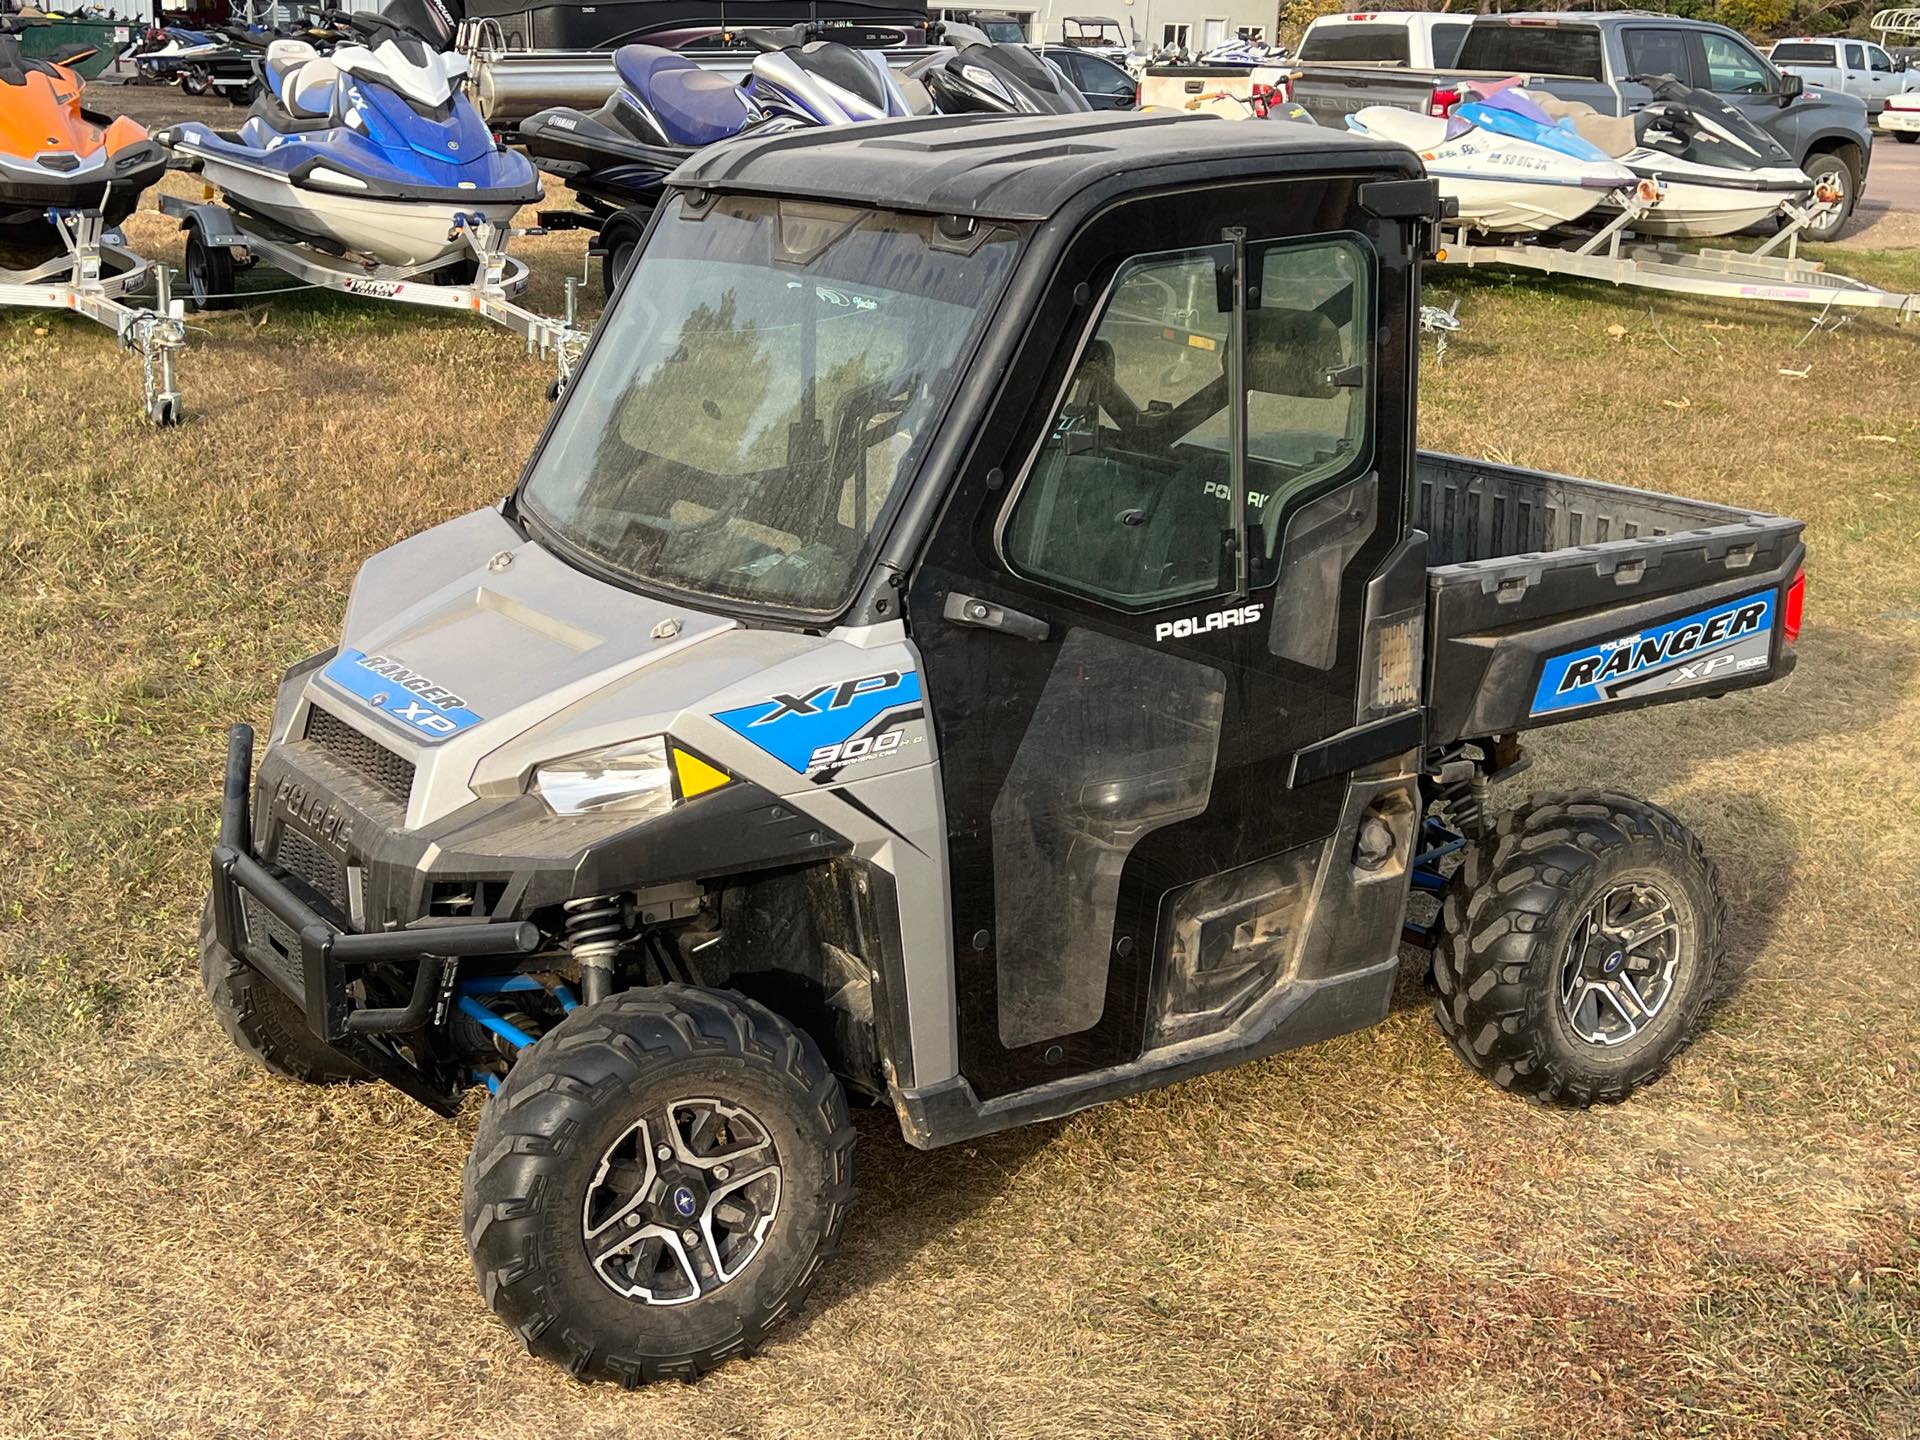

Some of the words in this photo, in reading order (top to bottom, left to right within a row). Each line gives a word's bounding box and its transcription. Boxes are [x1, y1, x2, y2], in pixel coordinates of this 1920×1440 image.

[1295, 95, 1418, 113] CHEVRT
[1203, 481, 1270, 509] PORI
[1156, 604, 1262, 642] POLARIS
[1556, 601, 1768, 695] RANGER
[1600, 634, 1642, 653] POLARIS
[355, 655, 468, 712] RANGER
[1667, 654, 1735, 686] XP
[391, 701, 458, 733] XP
[747, 670, 903, 728] XP
[808, 730, 905, 768] 900
[273, 775, 353, 853] POLARIS
